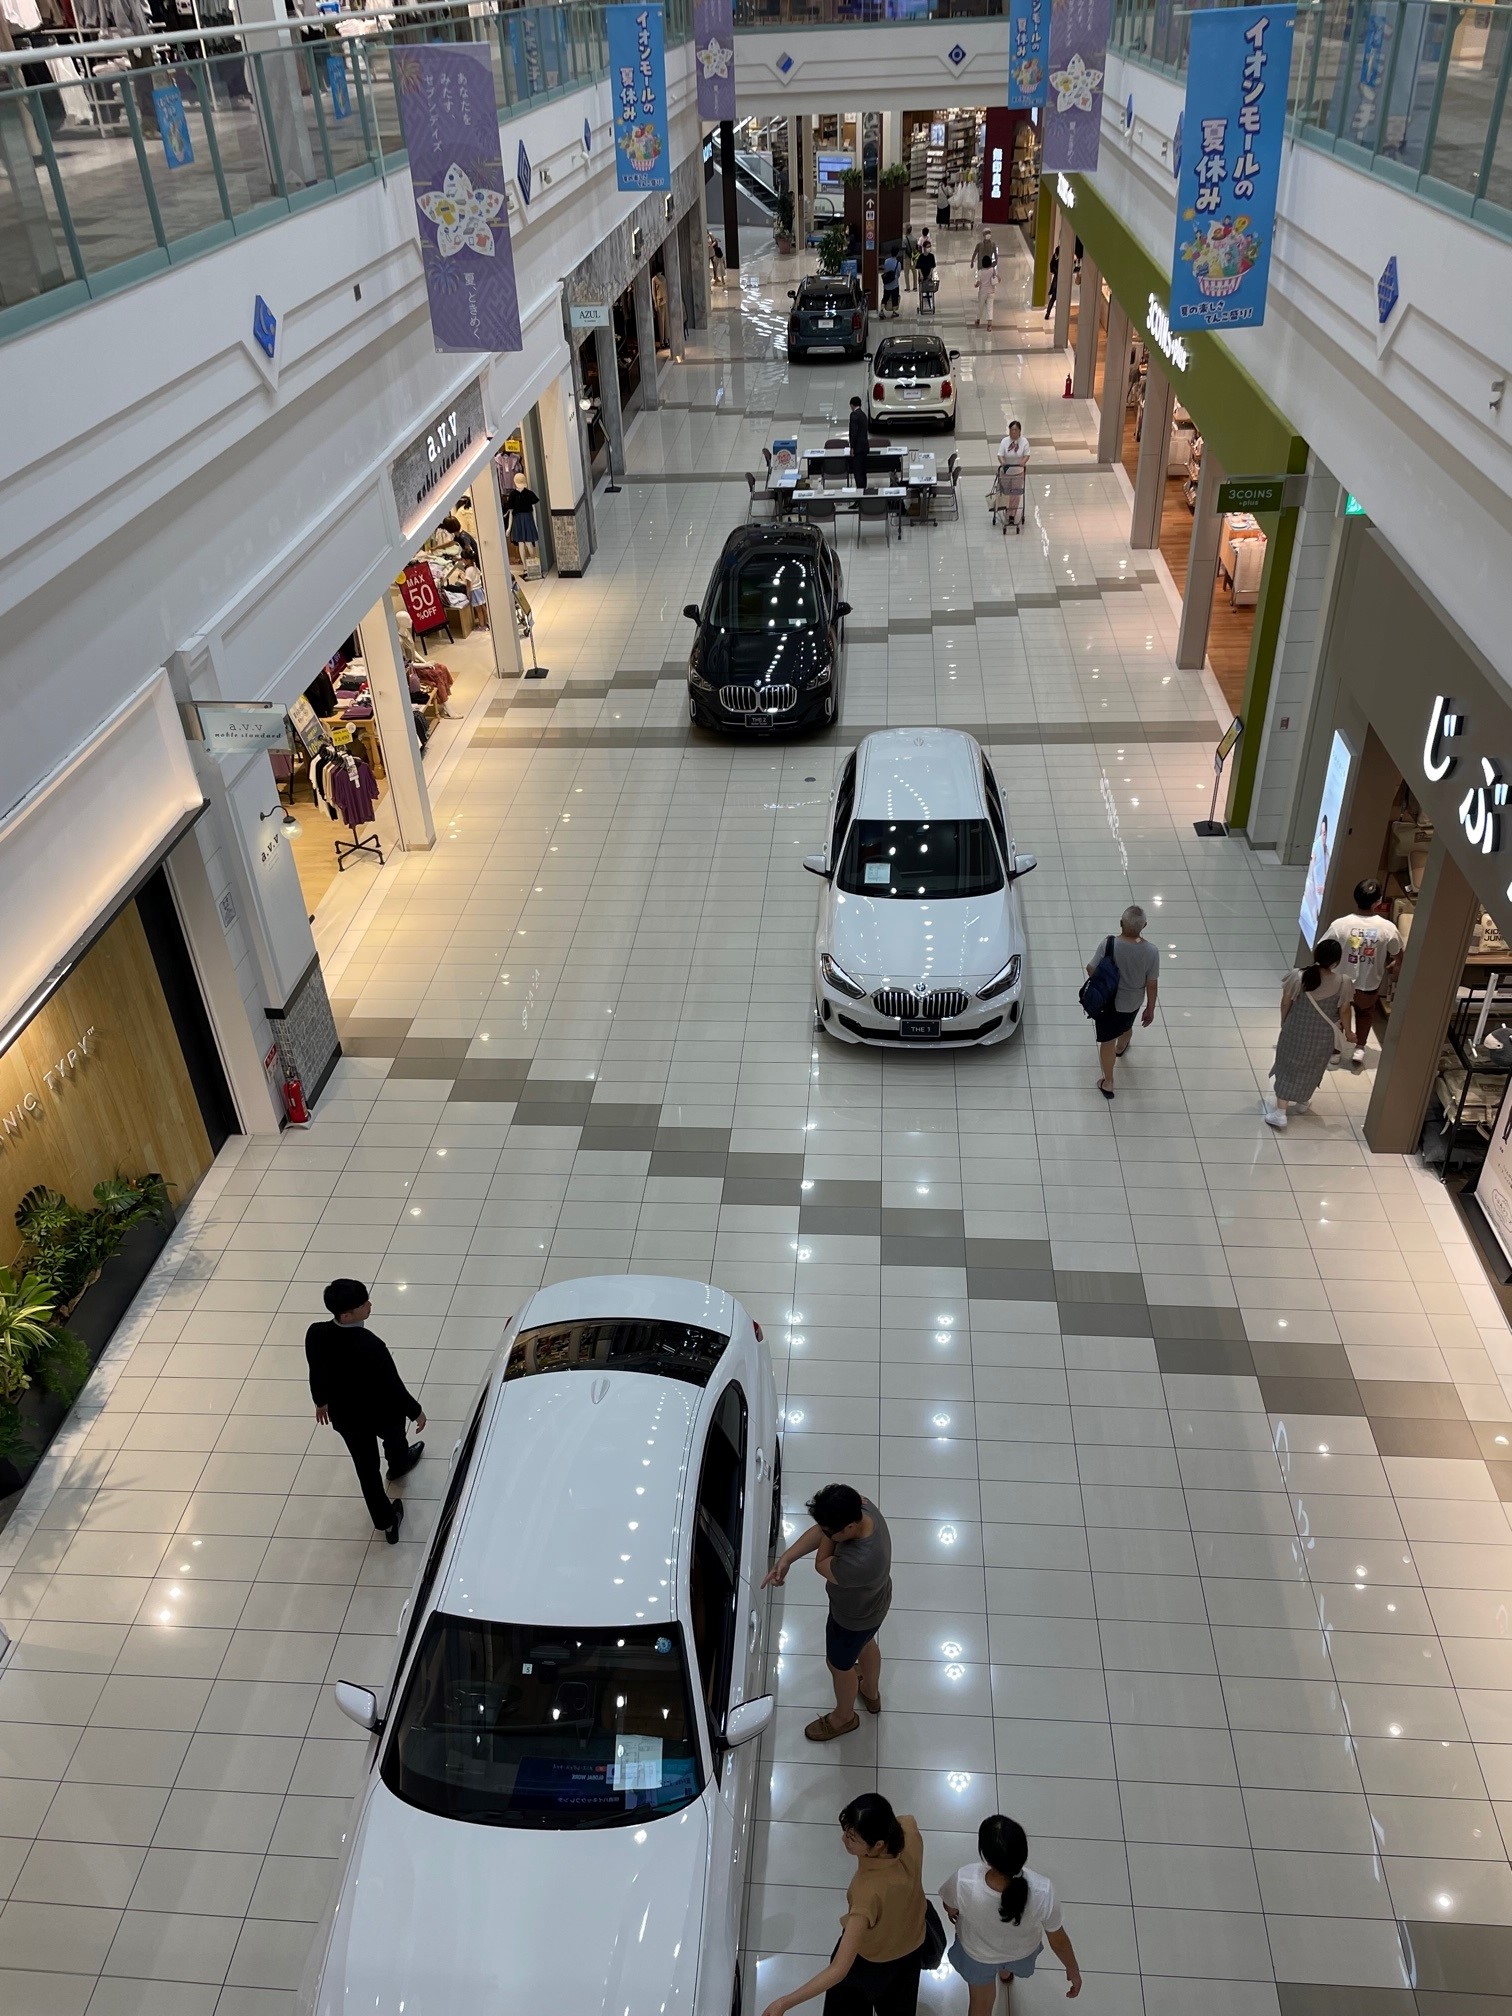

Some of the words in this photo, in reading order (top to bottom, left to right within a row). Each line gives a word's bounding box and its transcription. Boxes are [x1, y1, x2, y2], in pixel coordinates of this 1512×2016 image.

[1016, 17, 1029, 57] 夏休み
[636, 10, 656, 114] イオンモールの
[440, 73, 456, 120] みたす、
[457, 72, 472, 126] あなたを
[620, 67, 638, 121] 夏休み
[1234, 16, 1270, 198] イオンモールの
[1195, 118, 1227, 214] 夏休み
[463, 272, 480, 340] 夏、ときめく
[579, 310, 600, 319] AZUL
[1181, 302, 1224, 317] 夏の楽しさ
[1204, 308, 1253, 324] てんこ盛り!
[427, 411, 456, 462] a.v.v
[1228, 489, 1273, 499] 3COINS
[406, 574, 425, 588] MAX
[409, 584, 434, 611] 50
[416, 606, 437, 620] %OFF
[229, 723, 262, 731] a.v.v
[1424, 695, 1512, 902] じぶ
[261, 833, 279, 862] a.v.v
